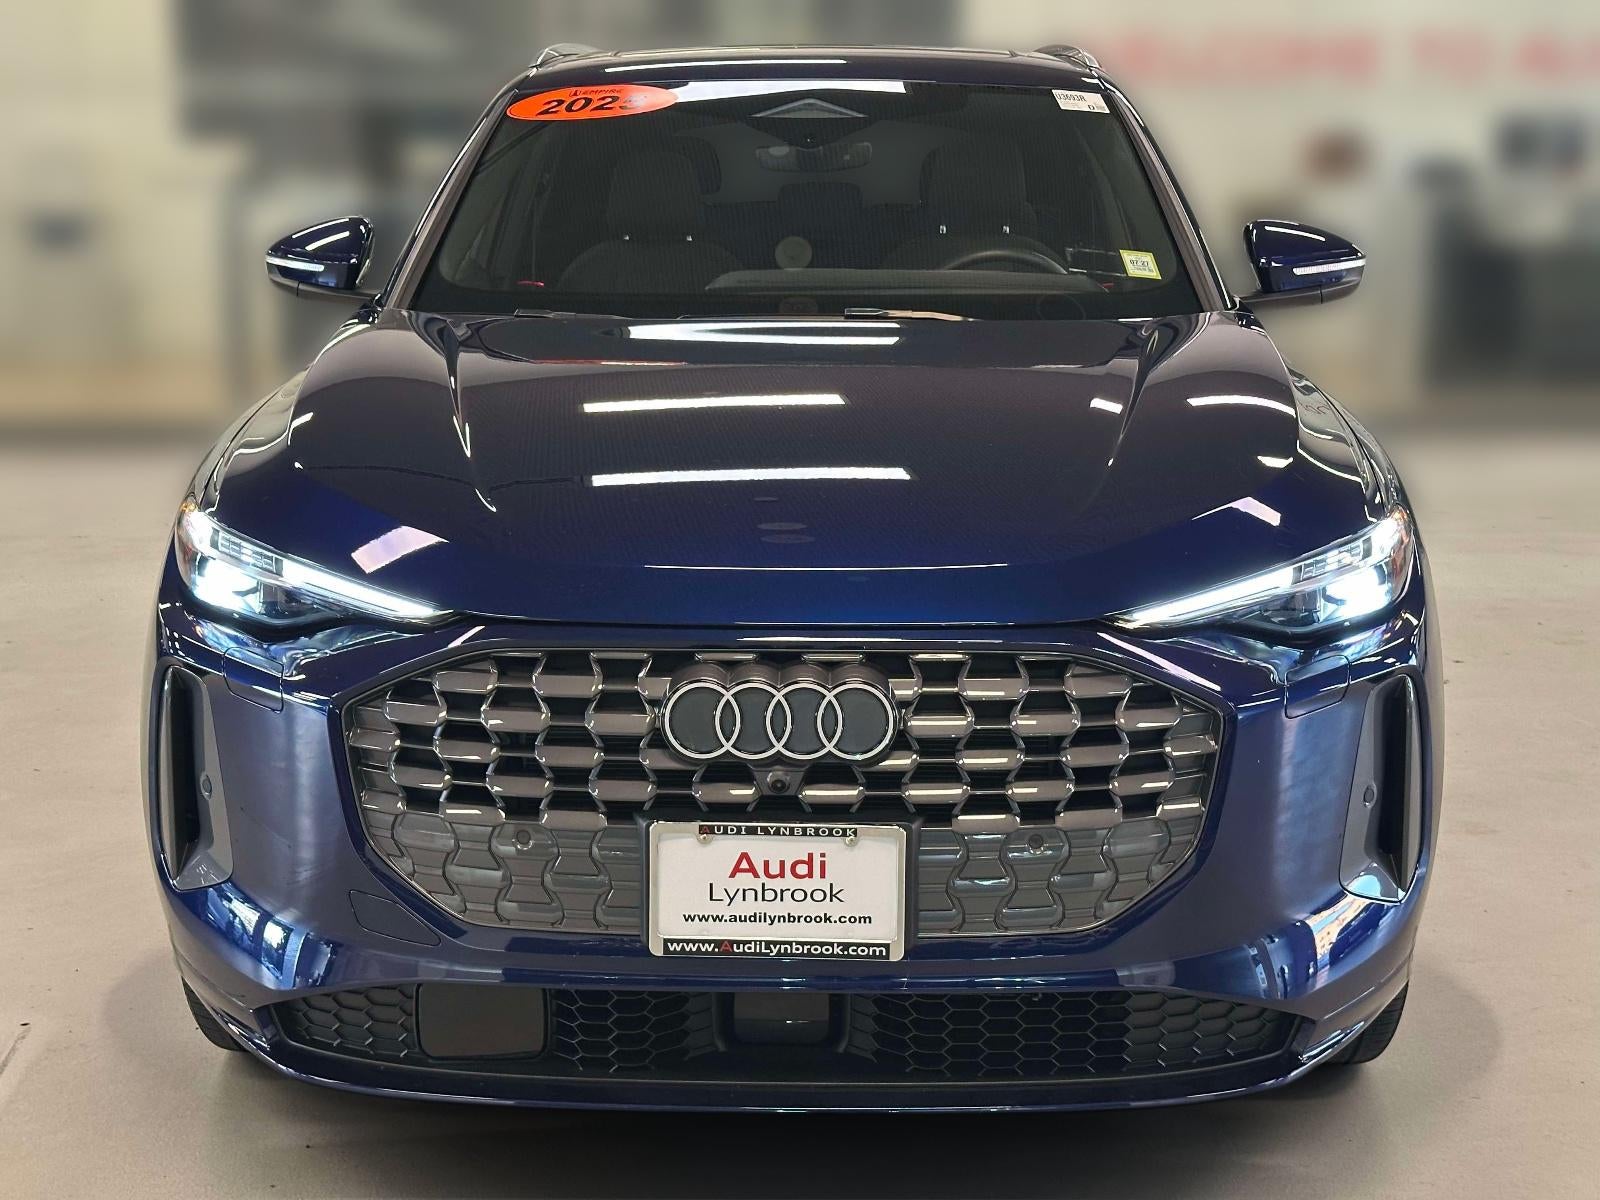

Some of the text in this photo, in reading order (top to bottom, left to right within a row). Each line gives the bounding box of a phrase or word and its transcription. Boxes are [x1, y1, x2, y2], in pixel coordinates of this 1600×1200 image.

[700, 825, 857, 837] AUDI LYNBROOK
[728, 851, 827, 879] Audi
[708, 883, 845, 906] Lynbrook
[682, 912, 873, 926] www.audilynbrook.com
[667, 940, 887, 957] www.AudiLynbrook.com
